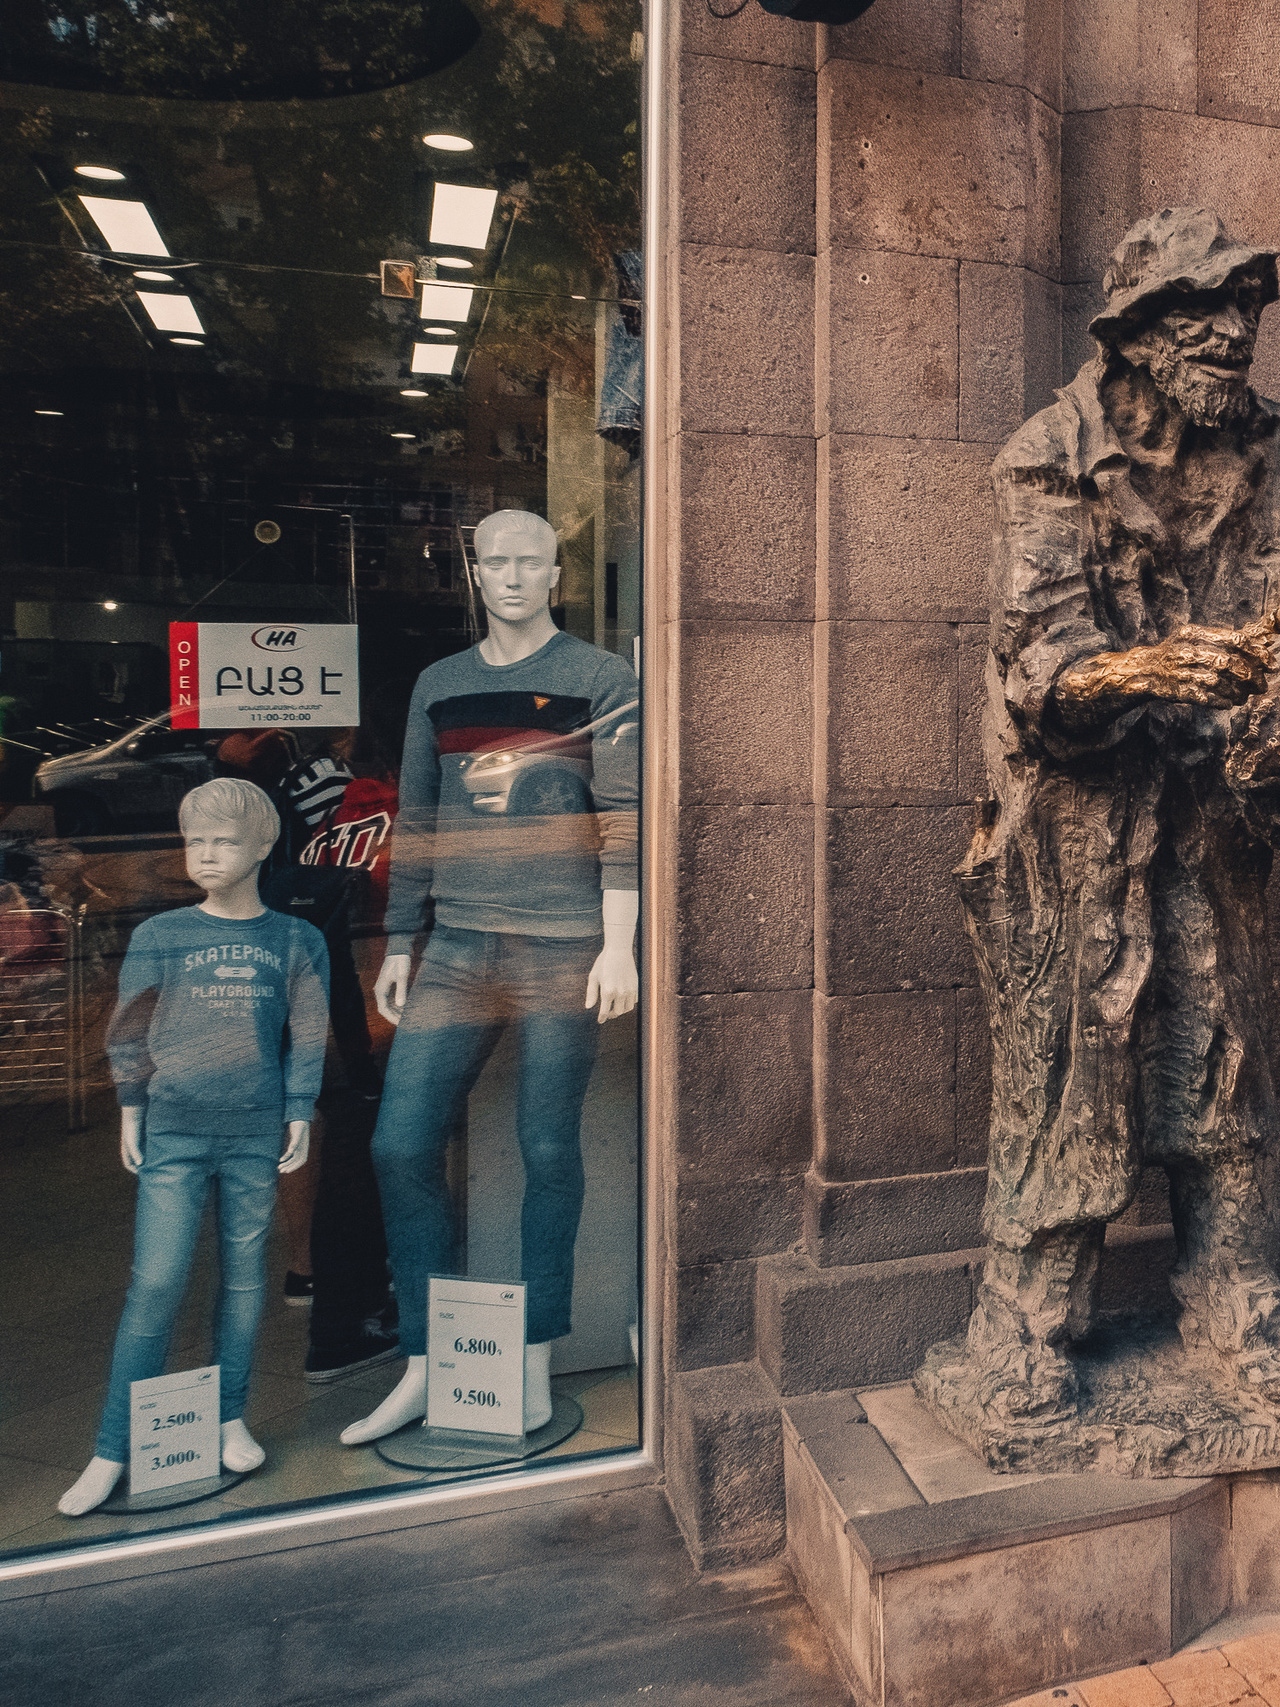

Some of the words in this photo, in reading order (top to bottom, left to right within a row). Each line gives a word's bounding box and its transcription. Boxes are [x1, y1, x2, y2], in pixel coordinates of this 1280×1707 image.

[266, 631, 297, 646] HA
[178, 641, 191, 706] OPEN
[251, 713, 311, 721] 11:00-20:00
[185, 944, 282, 972] SKATEPARK
[192, 985, 275, 998] PLAYGROUND
